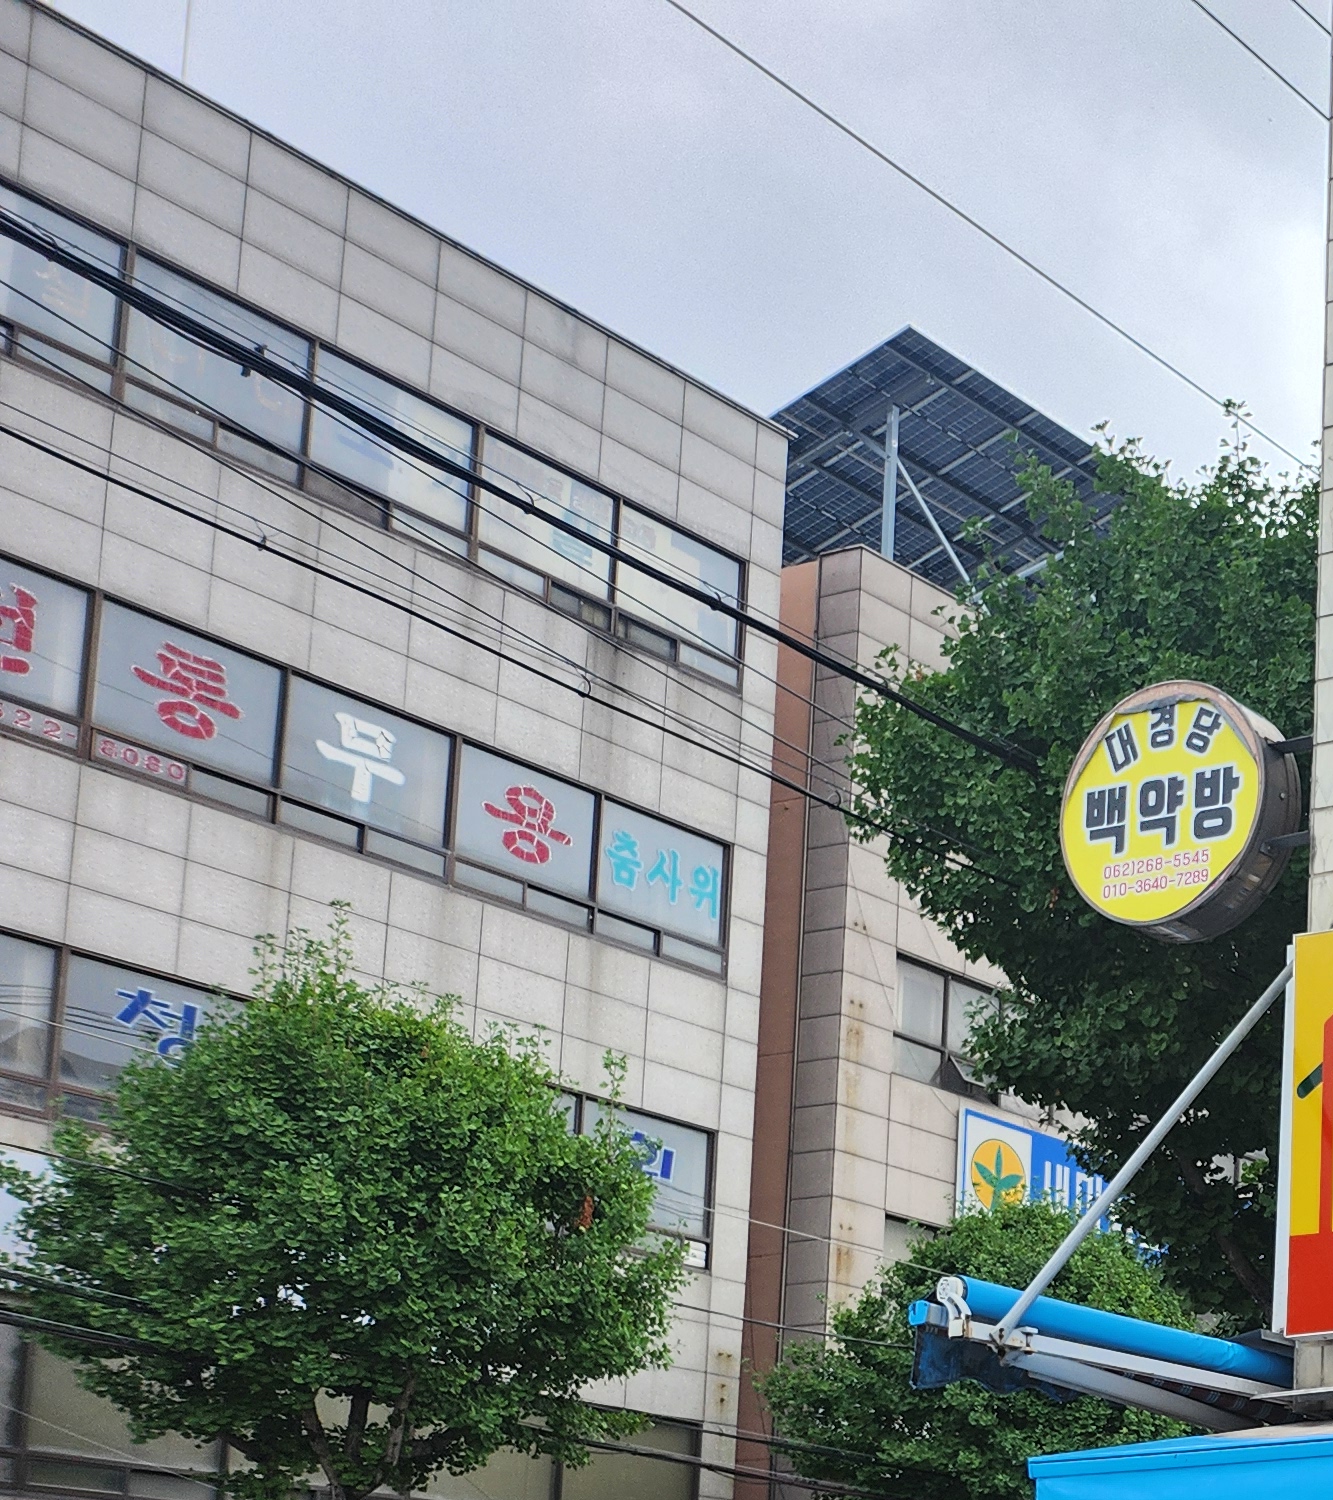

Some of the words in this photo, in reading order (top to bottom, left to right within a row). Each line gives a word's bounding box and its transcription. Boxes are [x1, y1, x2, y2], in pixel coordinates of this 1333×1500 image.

[1084, 765, 1241, 856] 백약방
[605, 829, 720, 920] 춤사위
[1103, 848, 1210, 881] 062)268-5545
